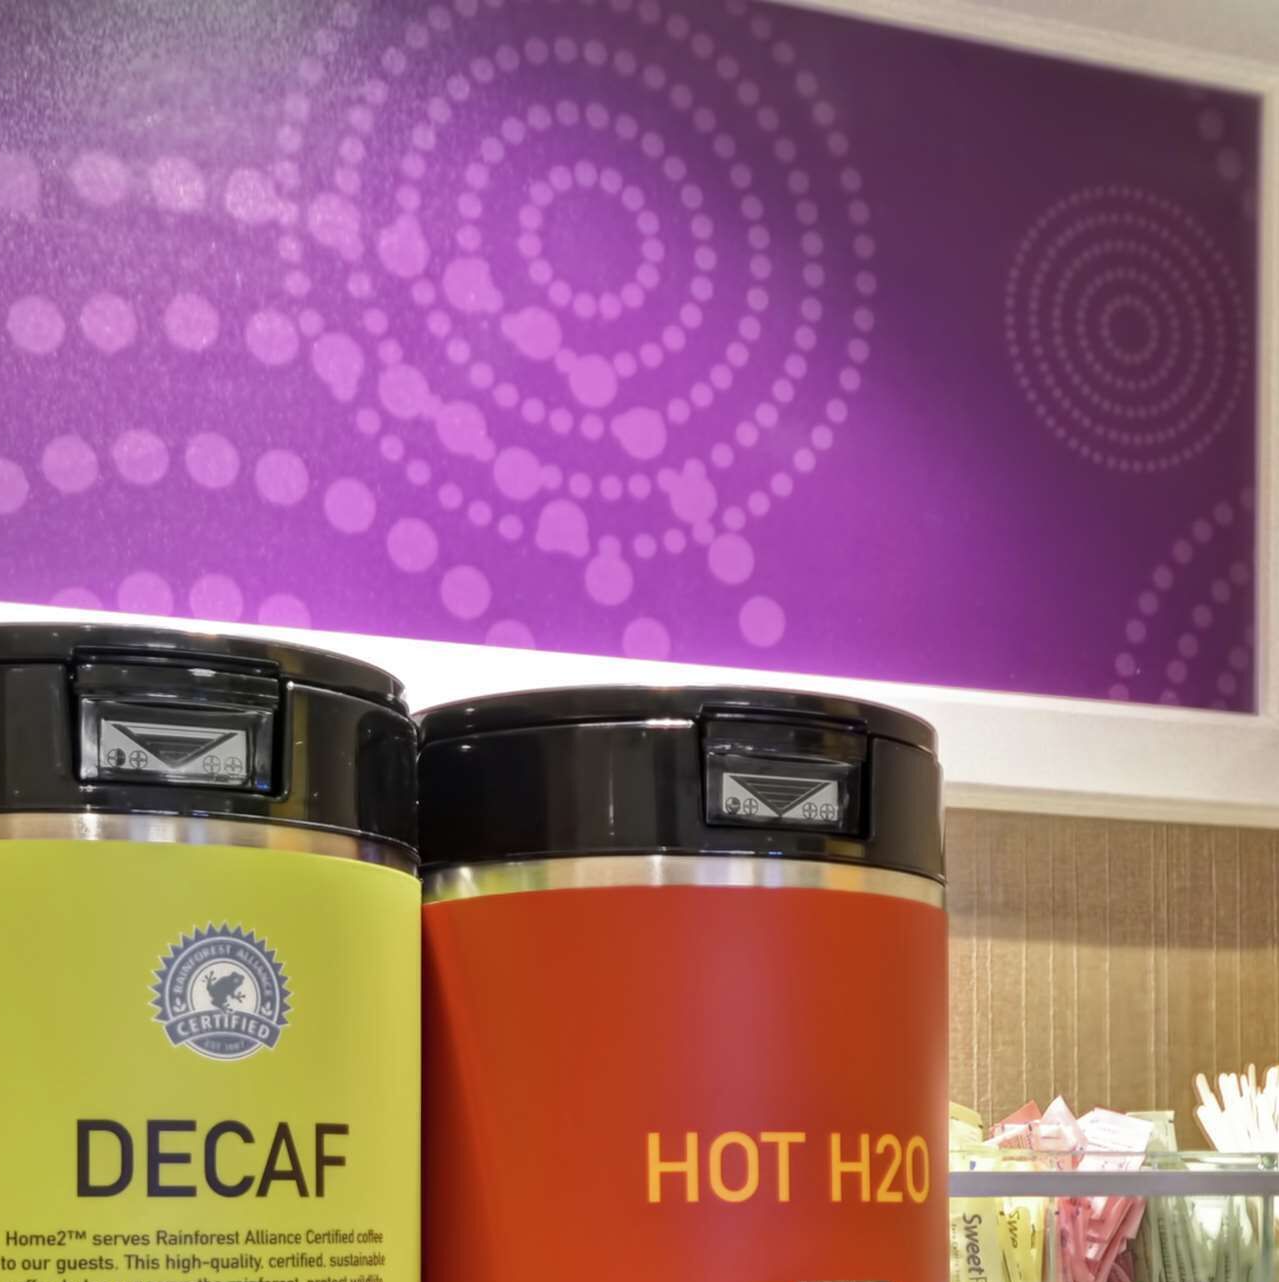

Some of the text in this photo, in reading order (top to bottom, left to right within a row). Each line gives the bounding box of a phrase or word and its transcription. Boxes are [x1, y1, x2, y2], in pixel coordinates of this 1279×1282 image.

[173, 944, 232, 995] RAINFOREST
[177, 1014, 270, 1040] CERTIFIED
[76, 1119, 349, 1198] DECAF
[648, 1131, 805, 1202] HOT
[92, 1233, 151, 1247] serves
[156, 1230, 240, 1246] Rainforest
[244, 1229, 302, 1246] Alliance
[306, 1229, 355, 1245] Certified
[356, 1229, 384, 1244] coffee
[0, 1256, 17, 1271] to
[21, 1258, 51, 1271] our
[56, 1256, 118, 1274] guests.
[123, 1254, 160, 1270] This
[329, 1251, 386, 1268] sustainable
